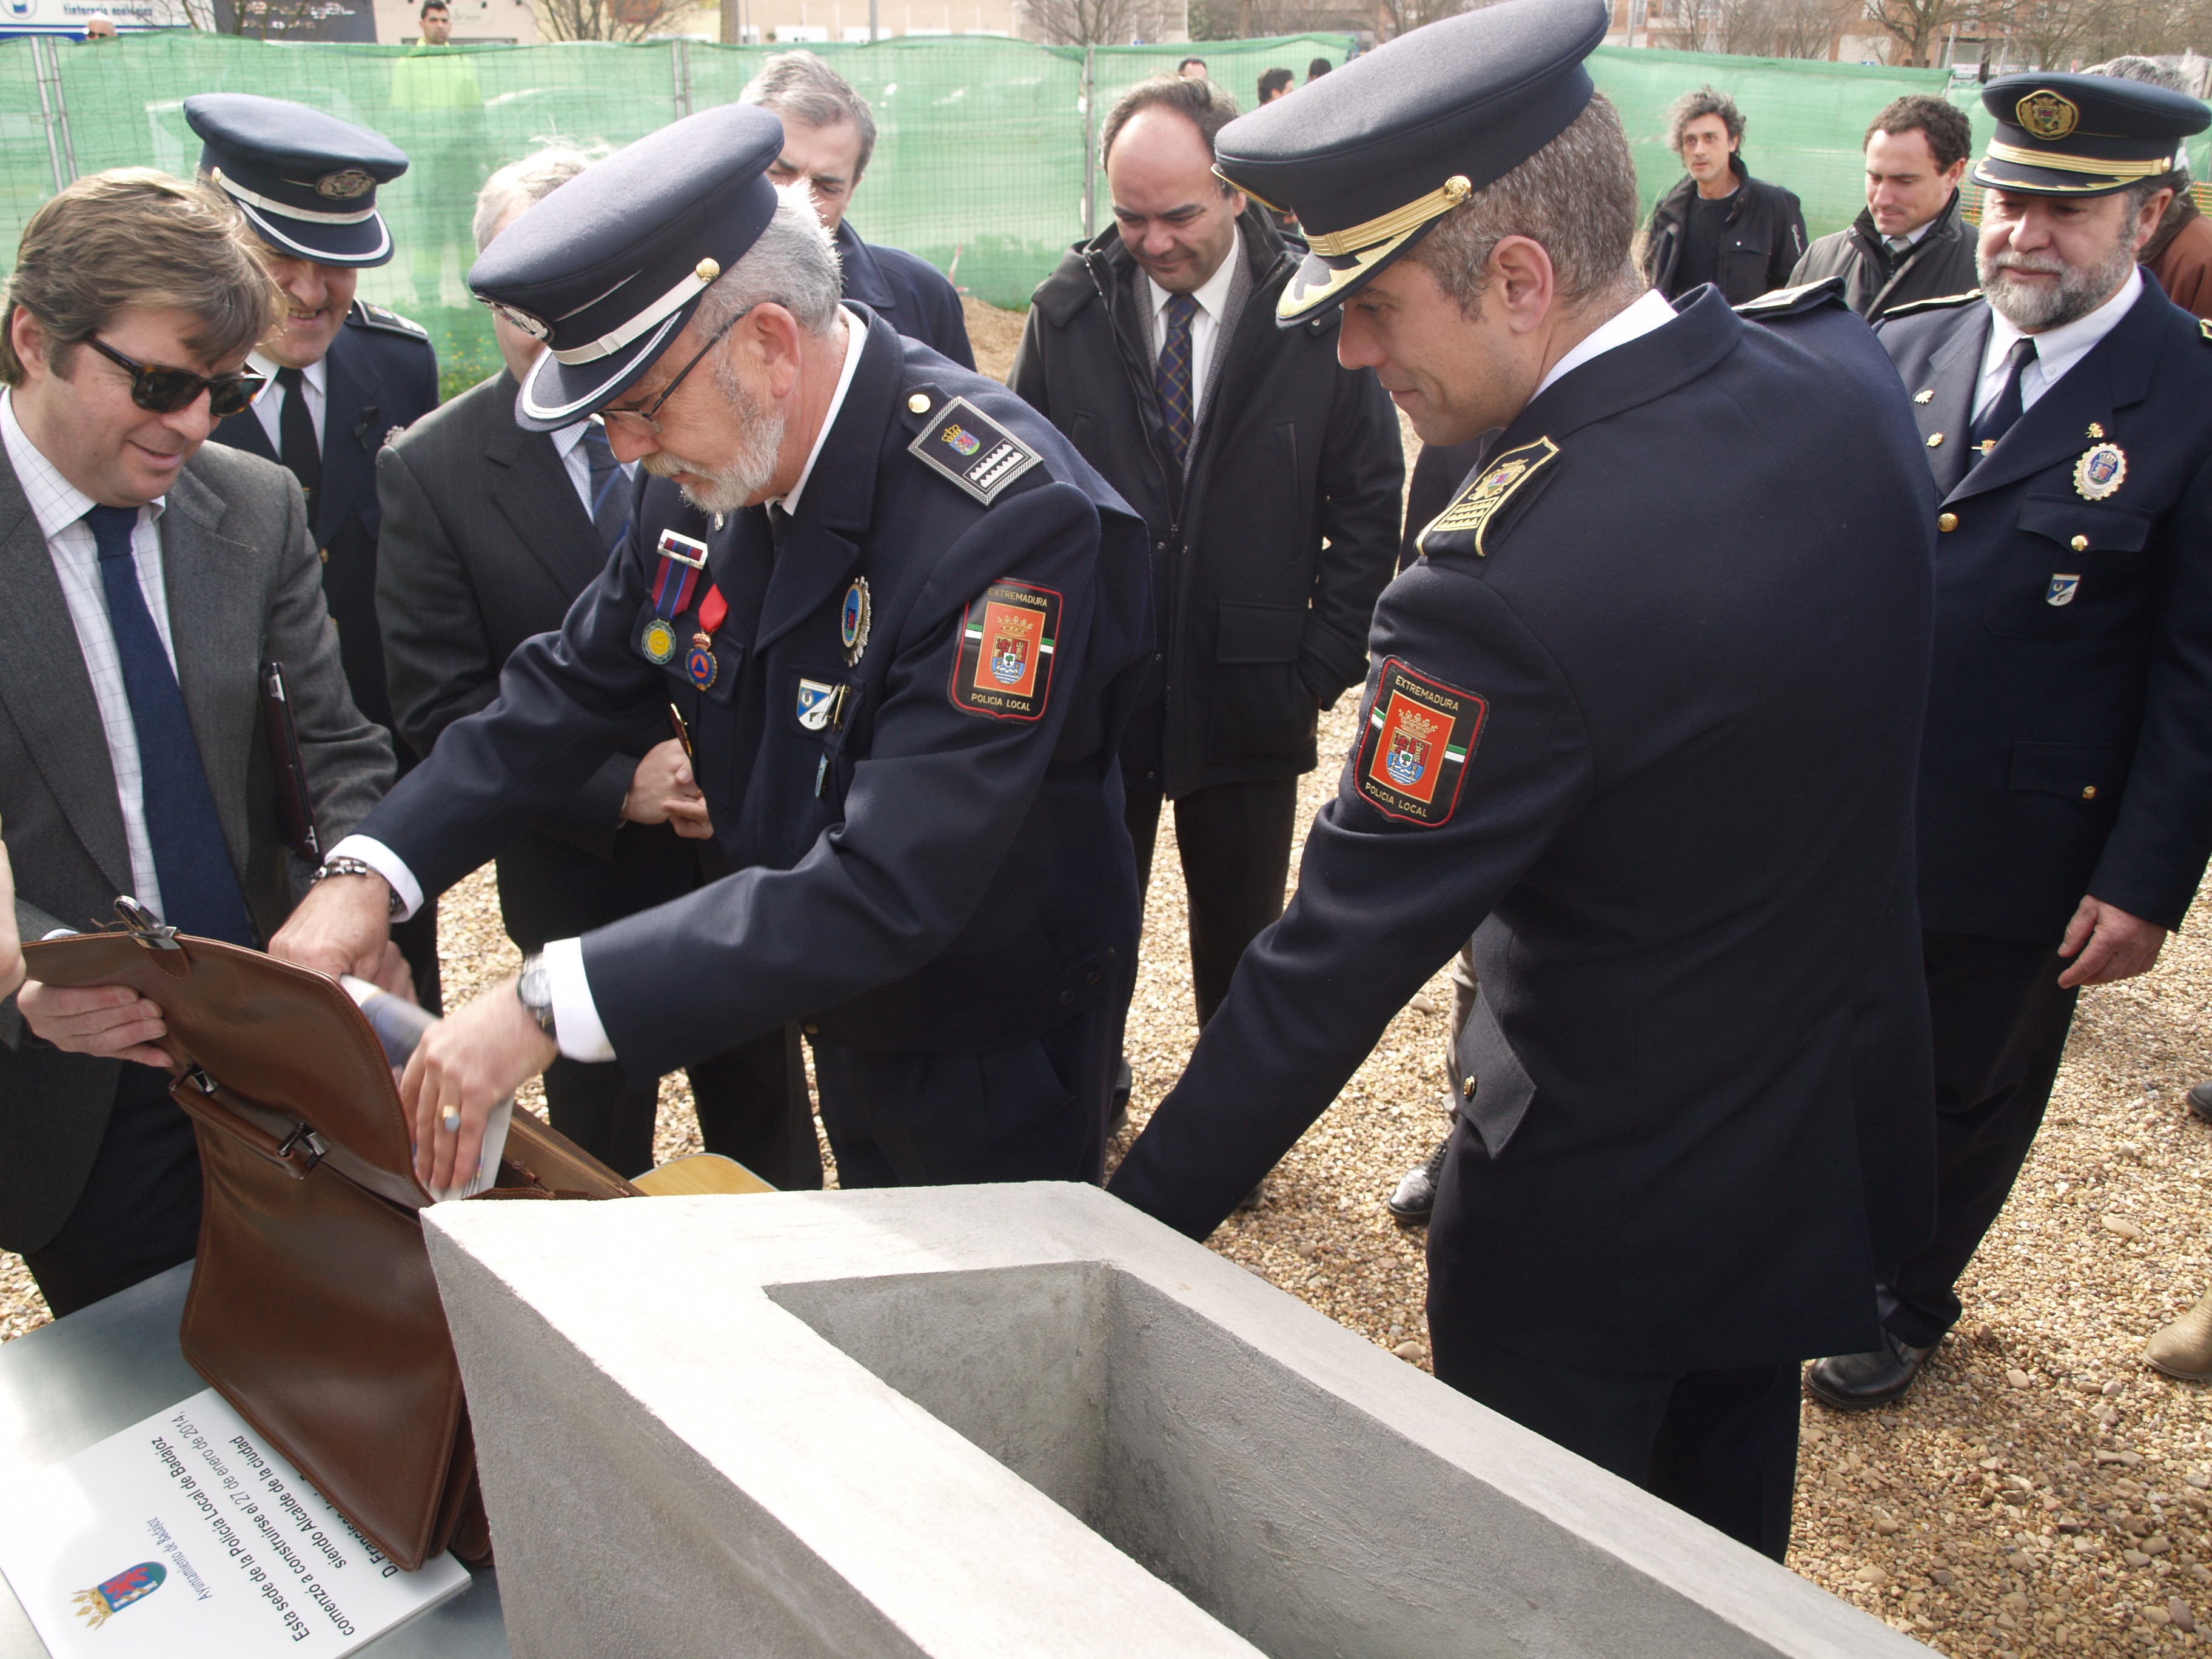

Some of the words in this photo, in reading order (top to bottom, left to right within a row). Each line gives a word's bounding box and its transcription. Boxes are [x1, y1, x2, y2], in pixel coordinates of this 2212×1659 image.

[988, 588, 1047, 607] EXTREMADURA
[971, 693, 1002, 706] POLICIA
[1006, 699, 1030, 711] LOCAL
[1395, 675, 1459, 711] EXTREMADURA
[1366, 782, 1394, 804] POLICIA
[1398, 800, 1427, 817] LOCAL
[172, 1410, 198, 1438] 2014,
[192, 1436, 208, 1449] de
[229, 1435, 264, 1468] ciudad
[152, 1436, 186, 1478] Badajoz
[203, 1449, 229, 1476] enero
[180, 1475, 196, 1489] de
[223, 1475, 239, 1489] de
[260, 1467, 273, 1481] la
[268, 1478, 284, 1493] de
[187, 1489, 218, 1521] Local
[229, 1491, 250, 1505] 27
[241, 1503, 258, 1515] el
[280, 1493, 317, 1532] Alcalde
[147, 1517, 171, 1545] Badajoz
[212, 1517, 246, 1557] Policía
[253, 1514, 306, 1574] construirse
[163, 1541, 178, 1553] de
[311, 1531, 347, 1569] siendo
[240, 1553, 255, 1569] la
[250, 1566, 267, 1582] de
[381, 1560, 399, 1578] D.
[172, 1551, 212, 1601] Ayuntamiento
[301, 1573, 313, 1583] a
[262, 1583, 289, 1611] sede
[304, 1583, 355, 1636] comenzó
[283, 1610, 310, 1642] Esta
